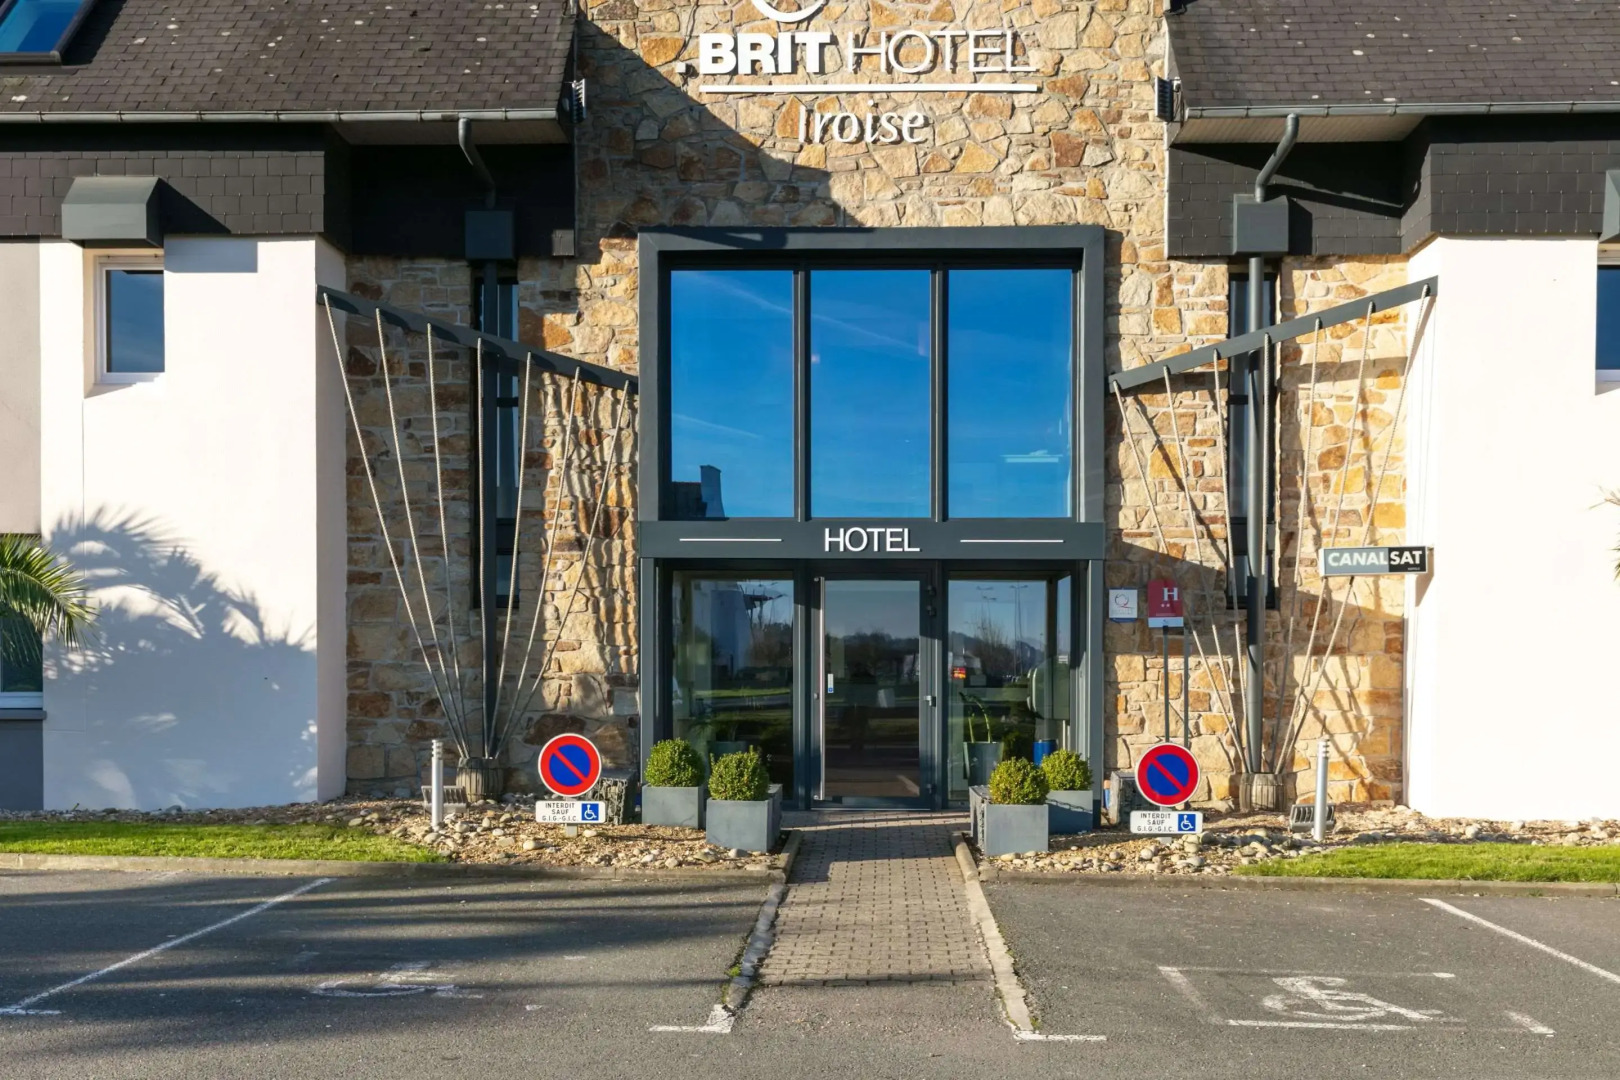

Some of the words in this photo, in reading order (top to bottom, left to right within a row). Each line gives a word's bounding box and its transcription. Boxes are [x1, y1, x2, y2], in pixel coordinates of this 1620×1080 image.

[699, 32, 830, 75] BRIT
[848, 31, 1037, 73] HOTEL
[799, 100, 928, 144] Iroise
[824, 527, 920, 552] HOTEL
[1163, 587, 1178, 601] H
